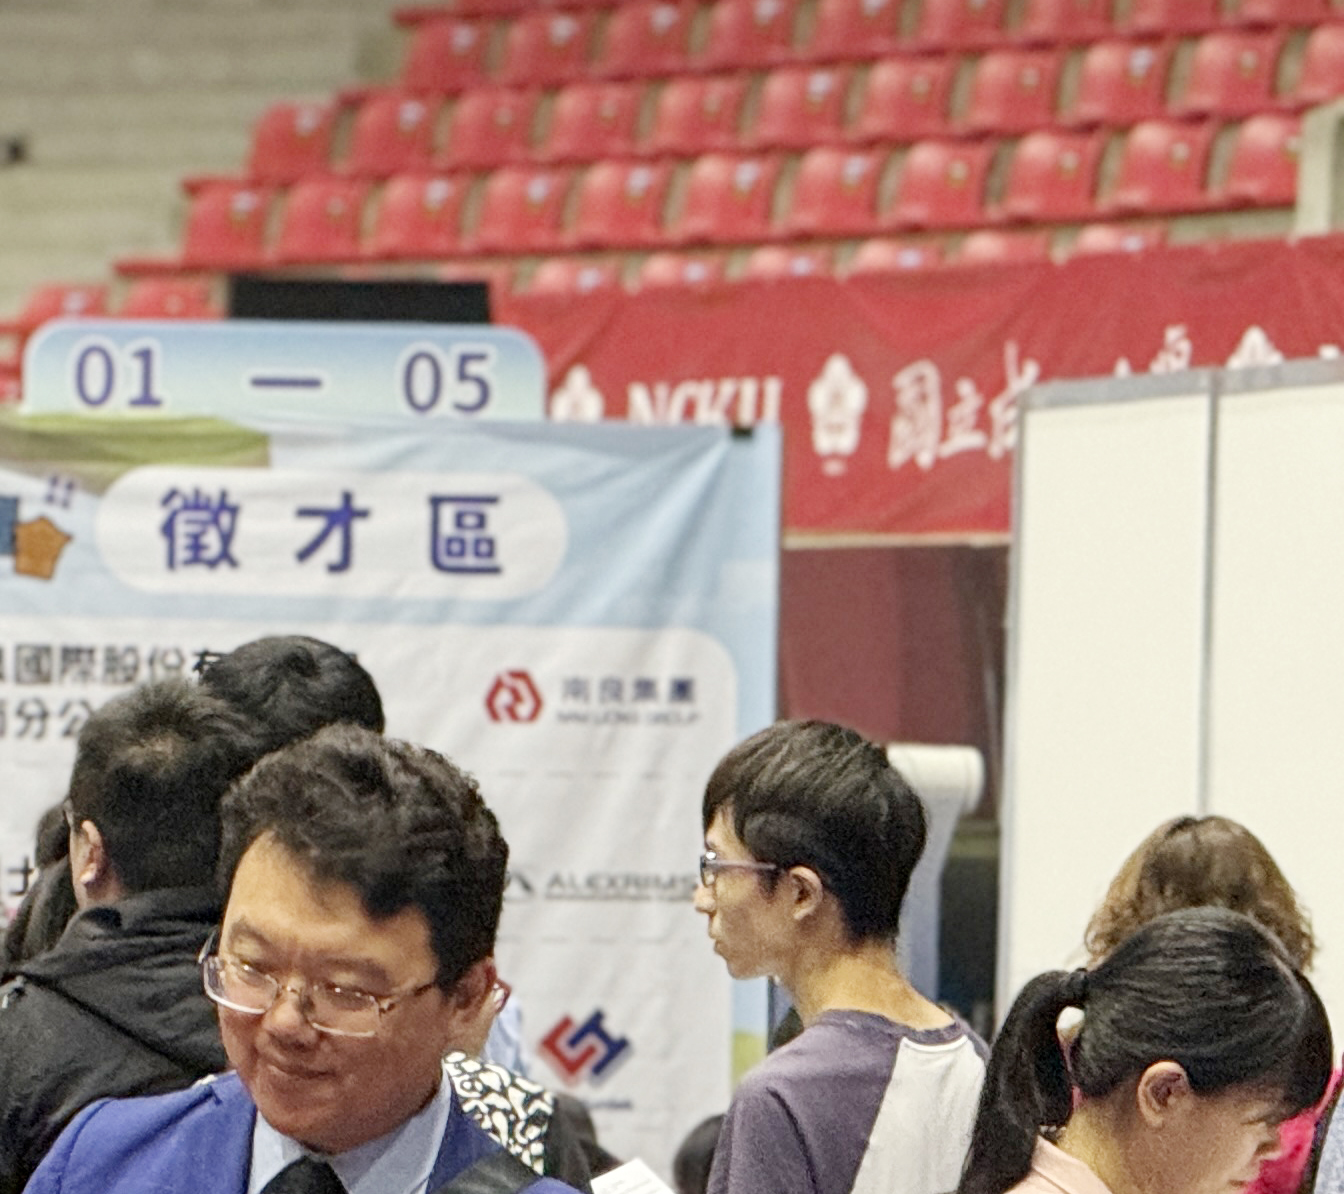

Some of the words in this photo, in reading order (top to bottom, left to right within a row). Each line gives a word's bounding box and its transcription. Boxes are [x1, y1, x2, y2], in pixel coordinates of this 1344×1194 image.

[75, 344, 163, 408] 01
[403, 351, 492, 413] 05
[160, 488, 503, 576] 徵才區
